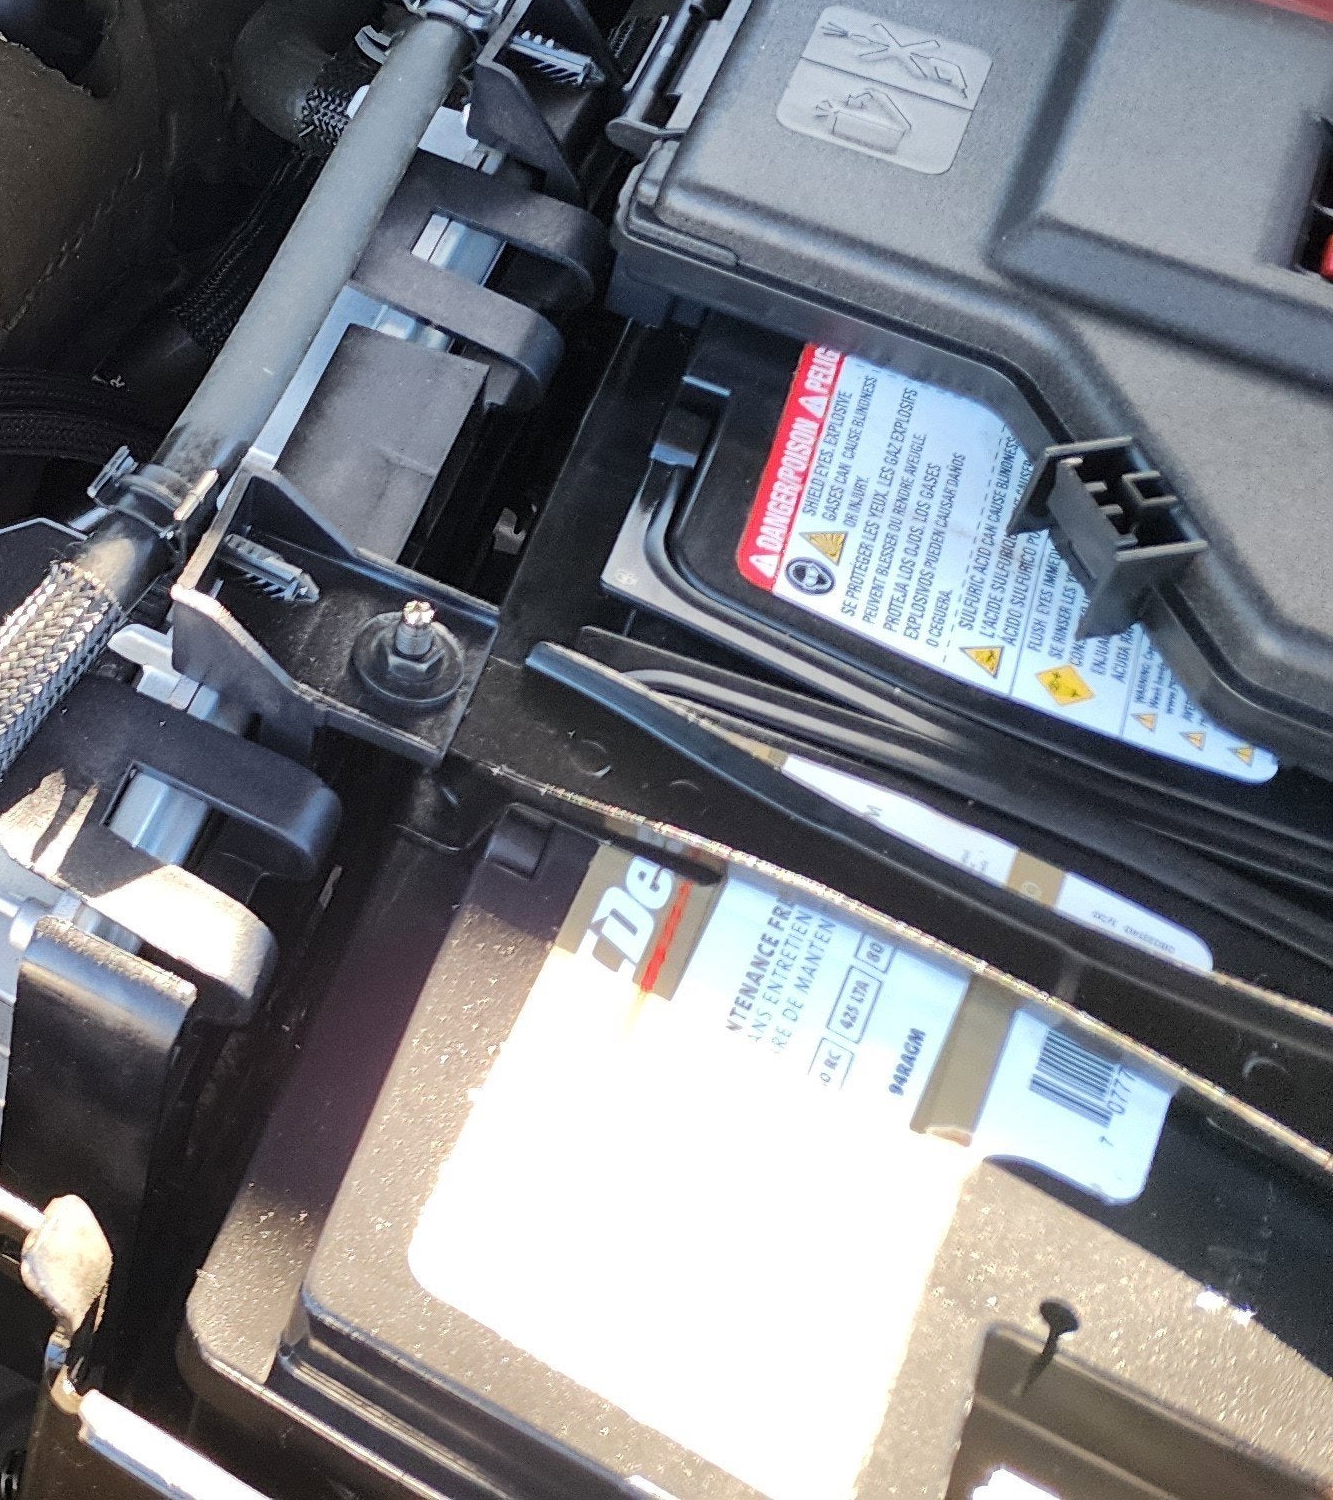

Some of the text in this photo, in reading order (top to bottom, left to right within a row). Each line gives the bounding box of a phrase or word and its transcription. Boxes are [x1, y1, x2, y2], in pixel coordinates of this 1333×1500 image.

[890, 387, 918, 442] EXPLOSIFS
[802, 478, 825, 516] SHIELD
[823, 390, 852, 446] EXPLOSIVE
[822, 375, 877, 521] GASES CAN CAUSE BLINDNESS
[883, 442, 902, 465] GAZ
[754, 416, 819, 553] DANGER/POISON
[879, 466, 895, 487] LES
[843, 476, 868, 527] OR INJURY.
[987, 490, 1006, 522] CAUSE
[862, 434, 926, 624] PEUVENT BLESSER OU RENDRE AVEUGLE.
[863, 520, 880, 542] LES
[883, 463, 941, 632] PROTEJA LOS OJOS. LOS GASES
[903, 452, 965, 640] EXPLOSIVOS PUEDEN CAUSAR DAÑOS
[981, 523, 997, 547] CAN
[973, 547, 991, 575] ACID
[840, 600, 857, 616] SE
[926, 590, 953, 647] O CEGUERA.
[958, 574, 985, 630] SULFURIC
[979, 593, 1004, 638] L'ACIDE
[1062, 586, 1077, 605] LES
[1027, 618, 1047, 652] FLUSH
[1037, 589, 1053, 614] EYES
[1052, 605, 1072, 643] RINSER
[1049, 646, 1064, 659] SE
[1092, 635, 1111, 674] ENJUA
[762, 909, 815, 1004] ENTRETIEN
[782, 998, 804, 1022] DE
[840, 980, 869, 1029] 425 LTA
[824, 1051, 841, 1070] RC
[889, 1028, 925, 1095] 94RAGM
